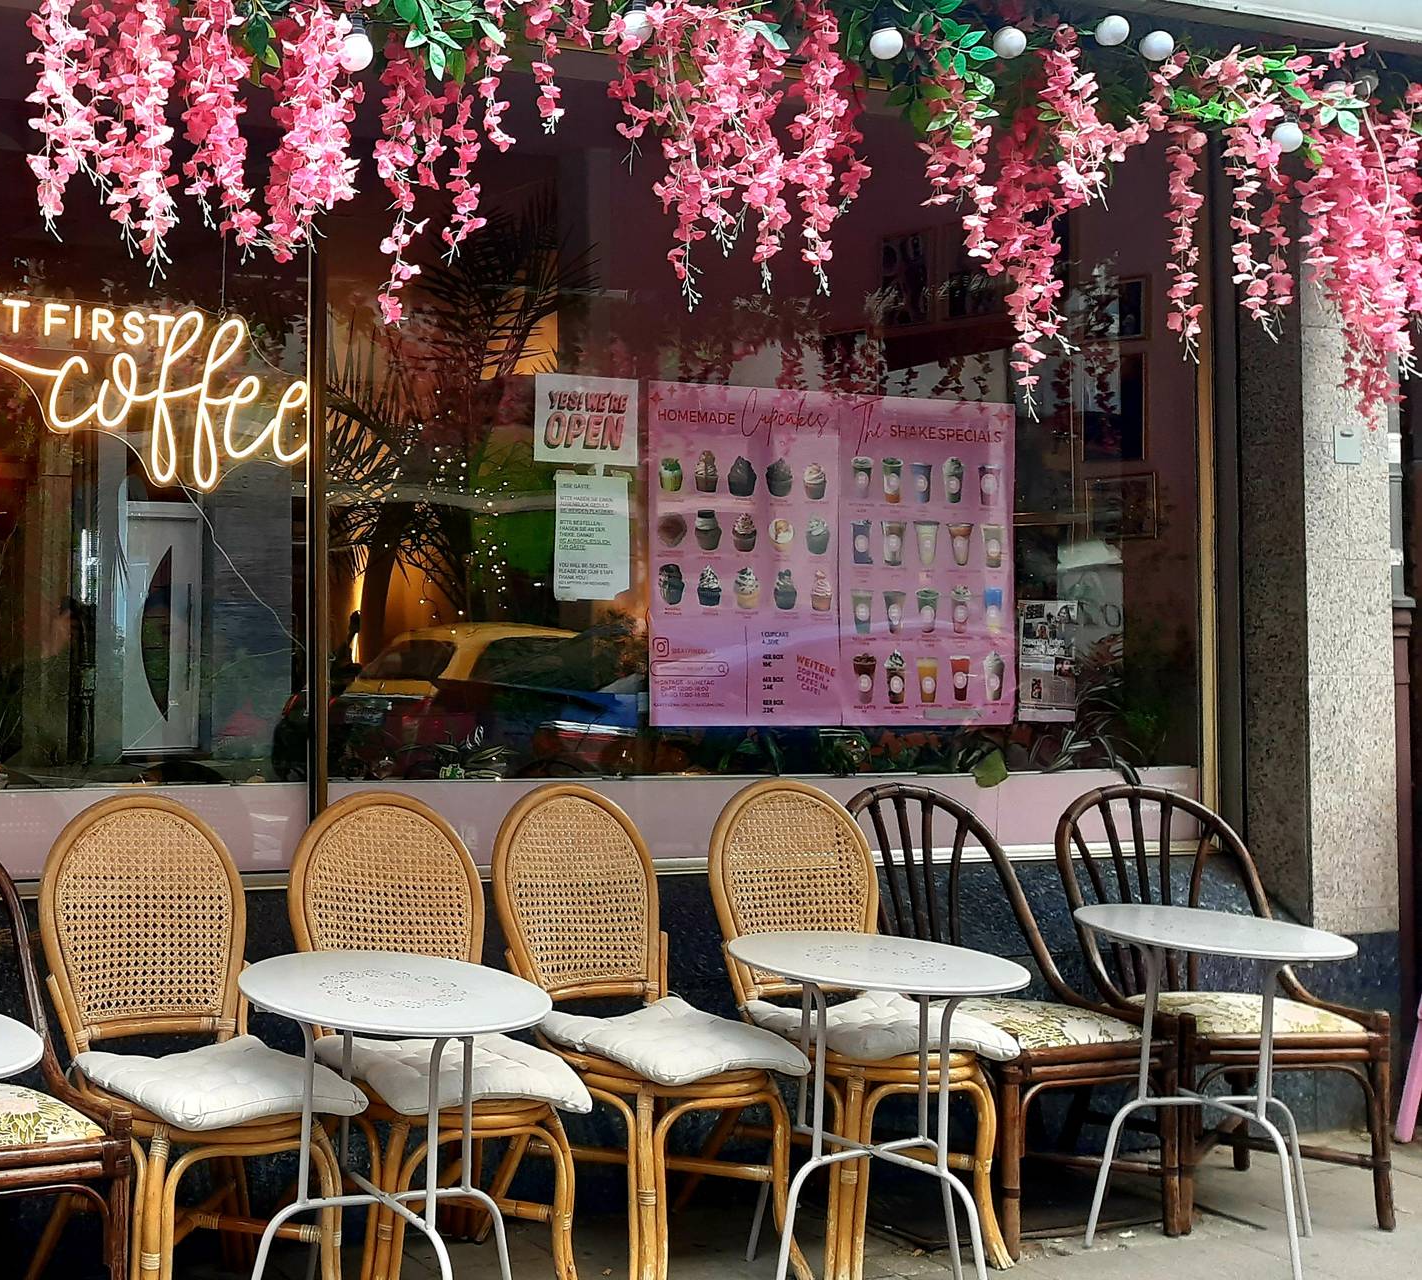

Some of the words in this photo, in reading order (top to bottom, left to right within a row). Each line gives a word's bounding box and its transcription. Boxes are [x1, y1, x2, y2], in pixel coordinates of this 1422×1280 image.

[44, 304, 176, 347] FIRST
[49, 311, 308, 489] coffee
[548, 390, 584, 411] YES!
[585, 391, 629, 414] WE'RE
[658, 408, 736, 425] HOMEMADE
[741, 389, 829, 447] Cupcakes
[544, 411, 625, 451] OPEN
[796, 654, 836, 678] WEITERE
